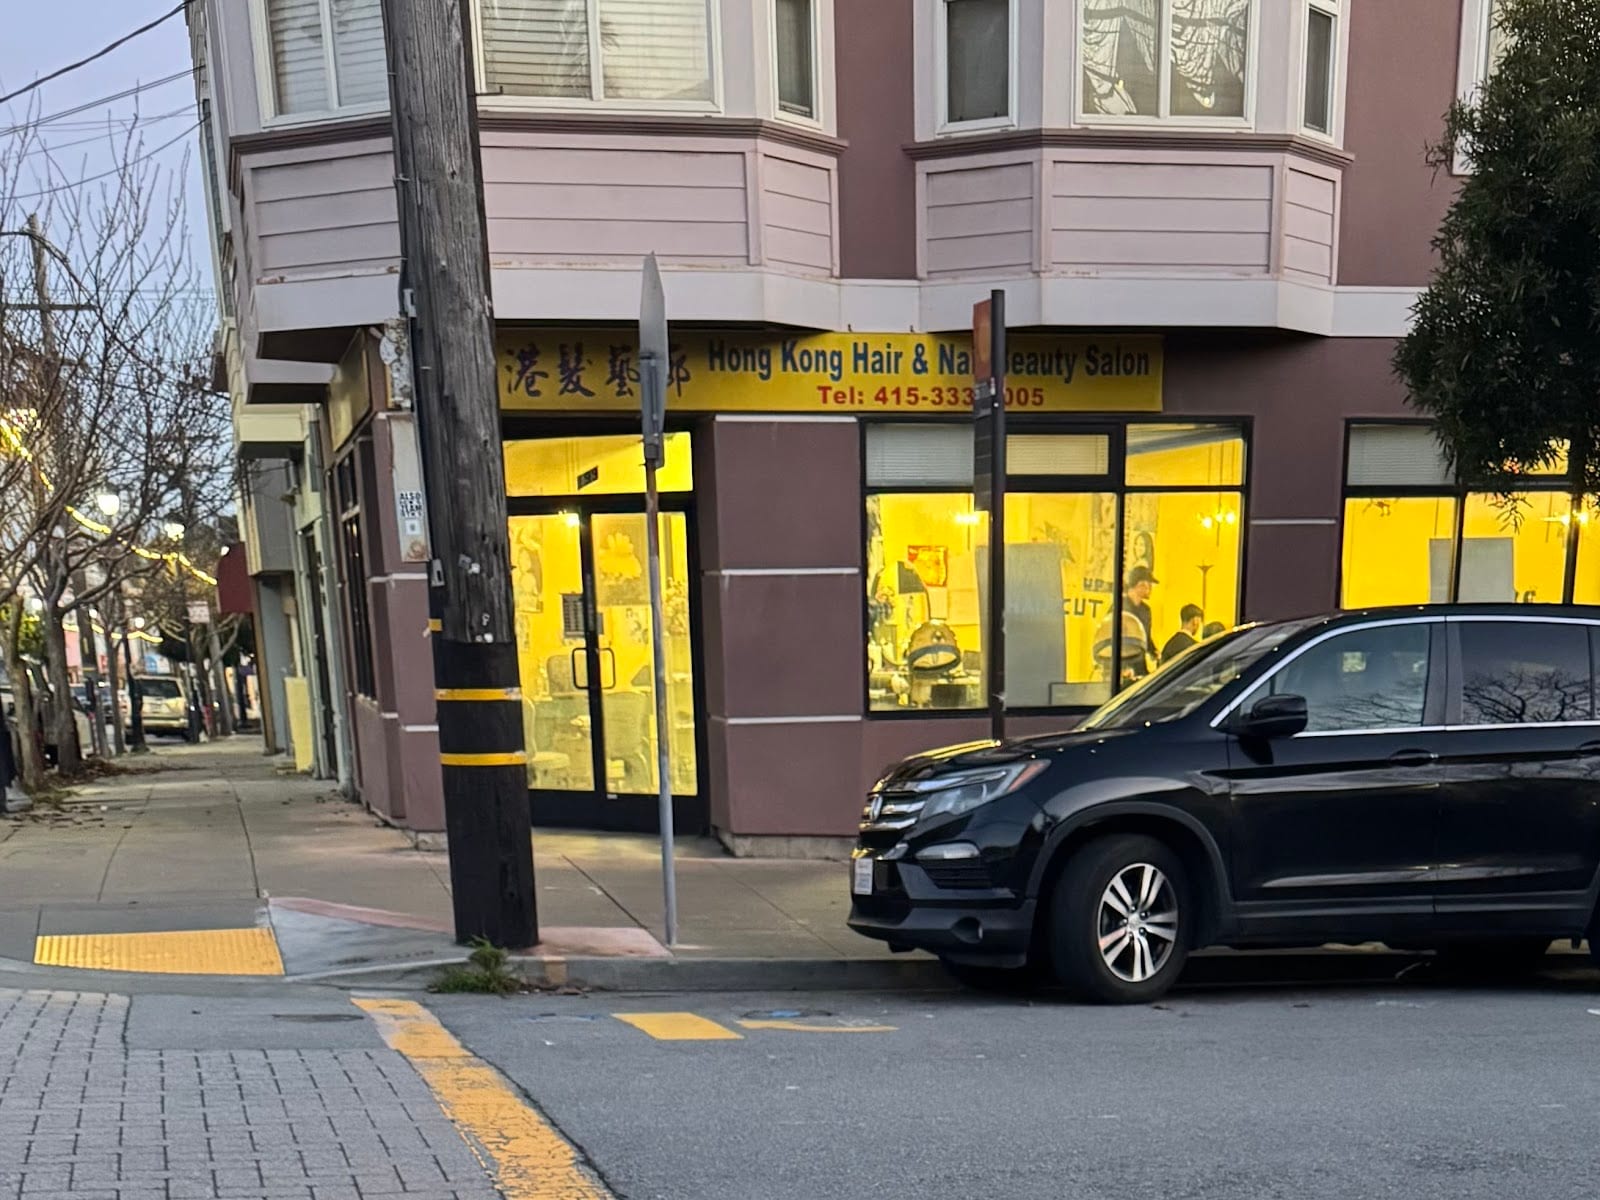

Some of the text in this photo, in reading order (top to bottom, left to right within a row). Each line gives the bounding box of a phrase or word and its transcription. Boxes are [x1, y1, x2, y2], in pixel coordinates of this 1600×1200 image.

[708, 338, 1150, 384] Hong Kong Hair & Na eauty Salon
[817, 386, 864, 406] Tel:
[1062, 597, 1104, 619] CUT
